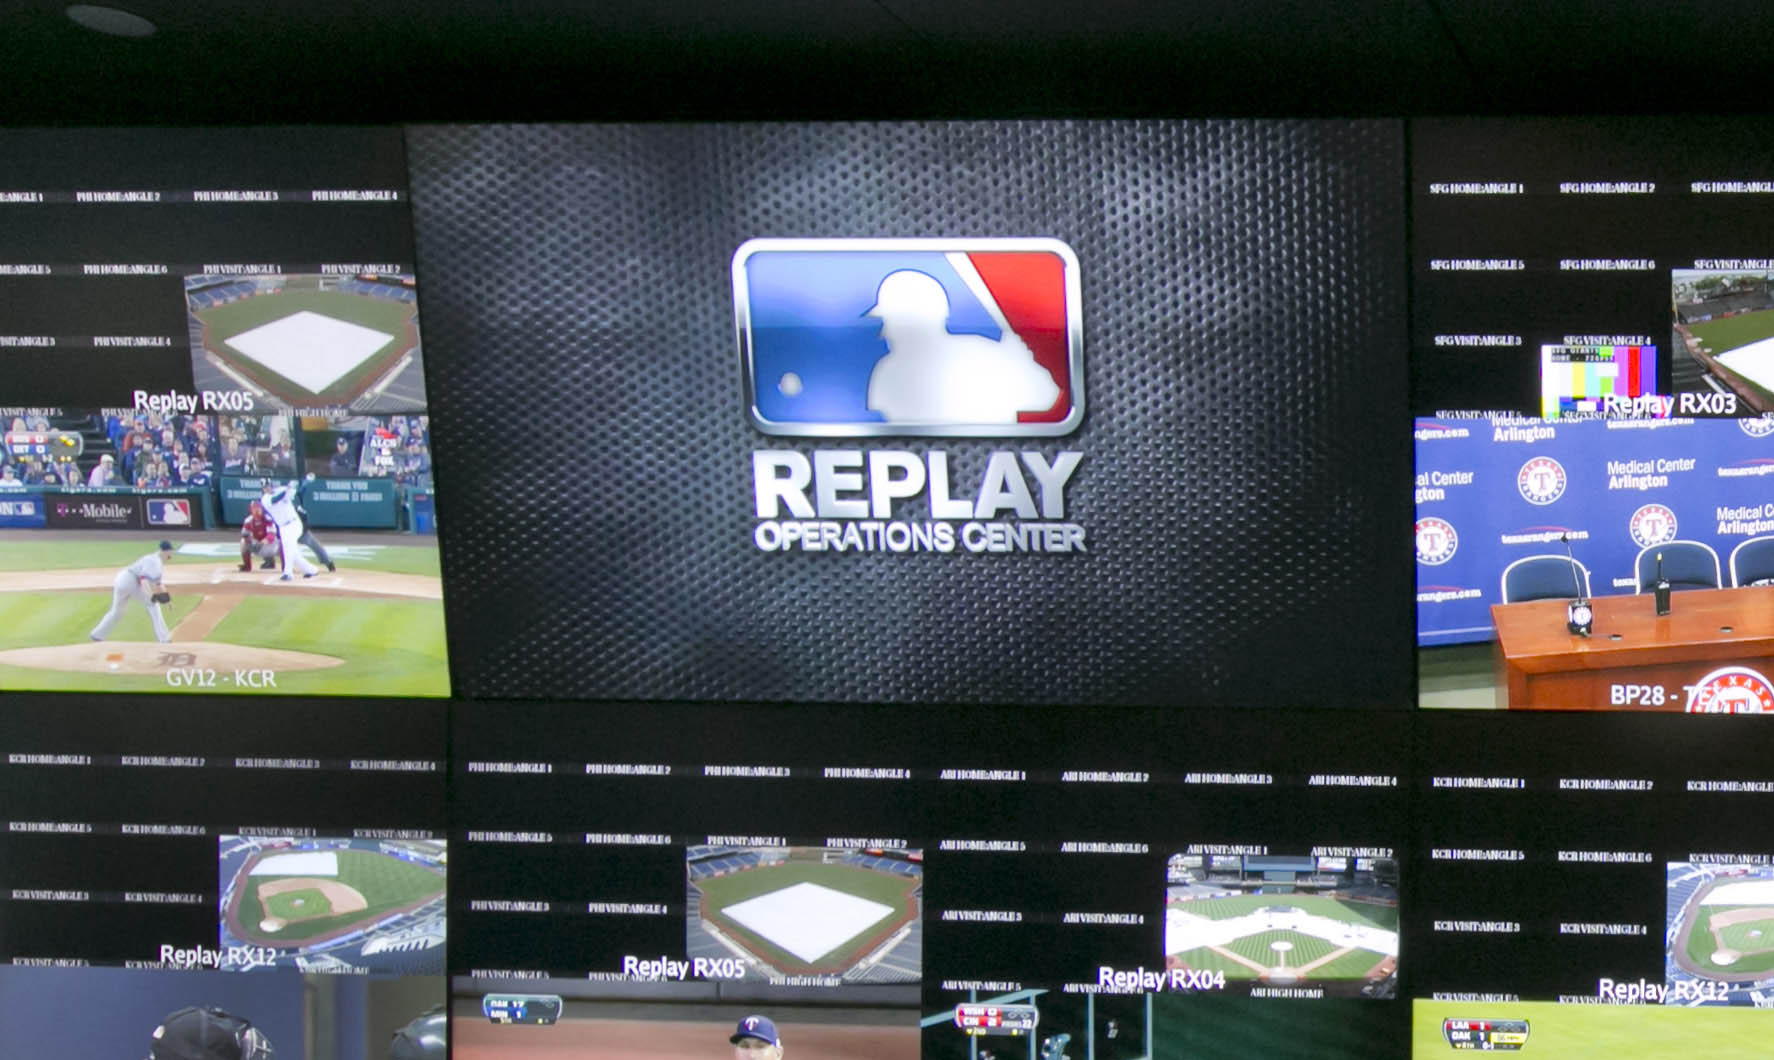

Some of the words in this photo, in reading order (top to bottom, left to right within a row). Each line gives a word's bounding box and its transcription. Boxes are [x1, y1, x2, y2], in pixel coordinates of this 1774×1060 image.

[133, 390, 198, 414] Replay
[203, 390, 254, 411] RX05
[1604, 392, 1673, 417] Replay
[1680, 393, 1737, 415] RX03
[1494, 426, 1556, 443] Arlington
[1607, 459, 1653, 475] Medical
[1656, 457, 1697, 474] Center
[752, 450, 1084, 520] REPLAY
[1432, 470, 1474, 487] Center
[1609, 473, 1668, 490] Arlington
[1716, 506, 1763, 522] Medical
[753, 521, 956, 553] OPERATIONS
[961, 521, 1088, 553] CENTER
[166, 669, 217, 688] GV12
[235, 669, 277, 688] KCR
[1611, 685, 1664, 706] BP28
[160, 944, 221, 968] Replay
[227, 946, 277, 966] RX12
[623, 955, 690, 980] Replay
[694, 957, 745, 978] RX05
[1099, 966, 1167, 993] Replay
[1171, 969, 1226, 991] RX04
[1599, 977, 1669, 1005] Replay
[1675, 981, 1729, 1002] RX12
